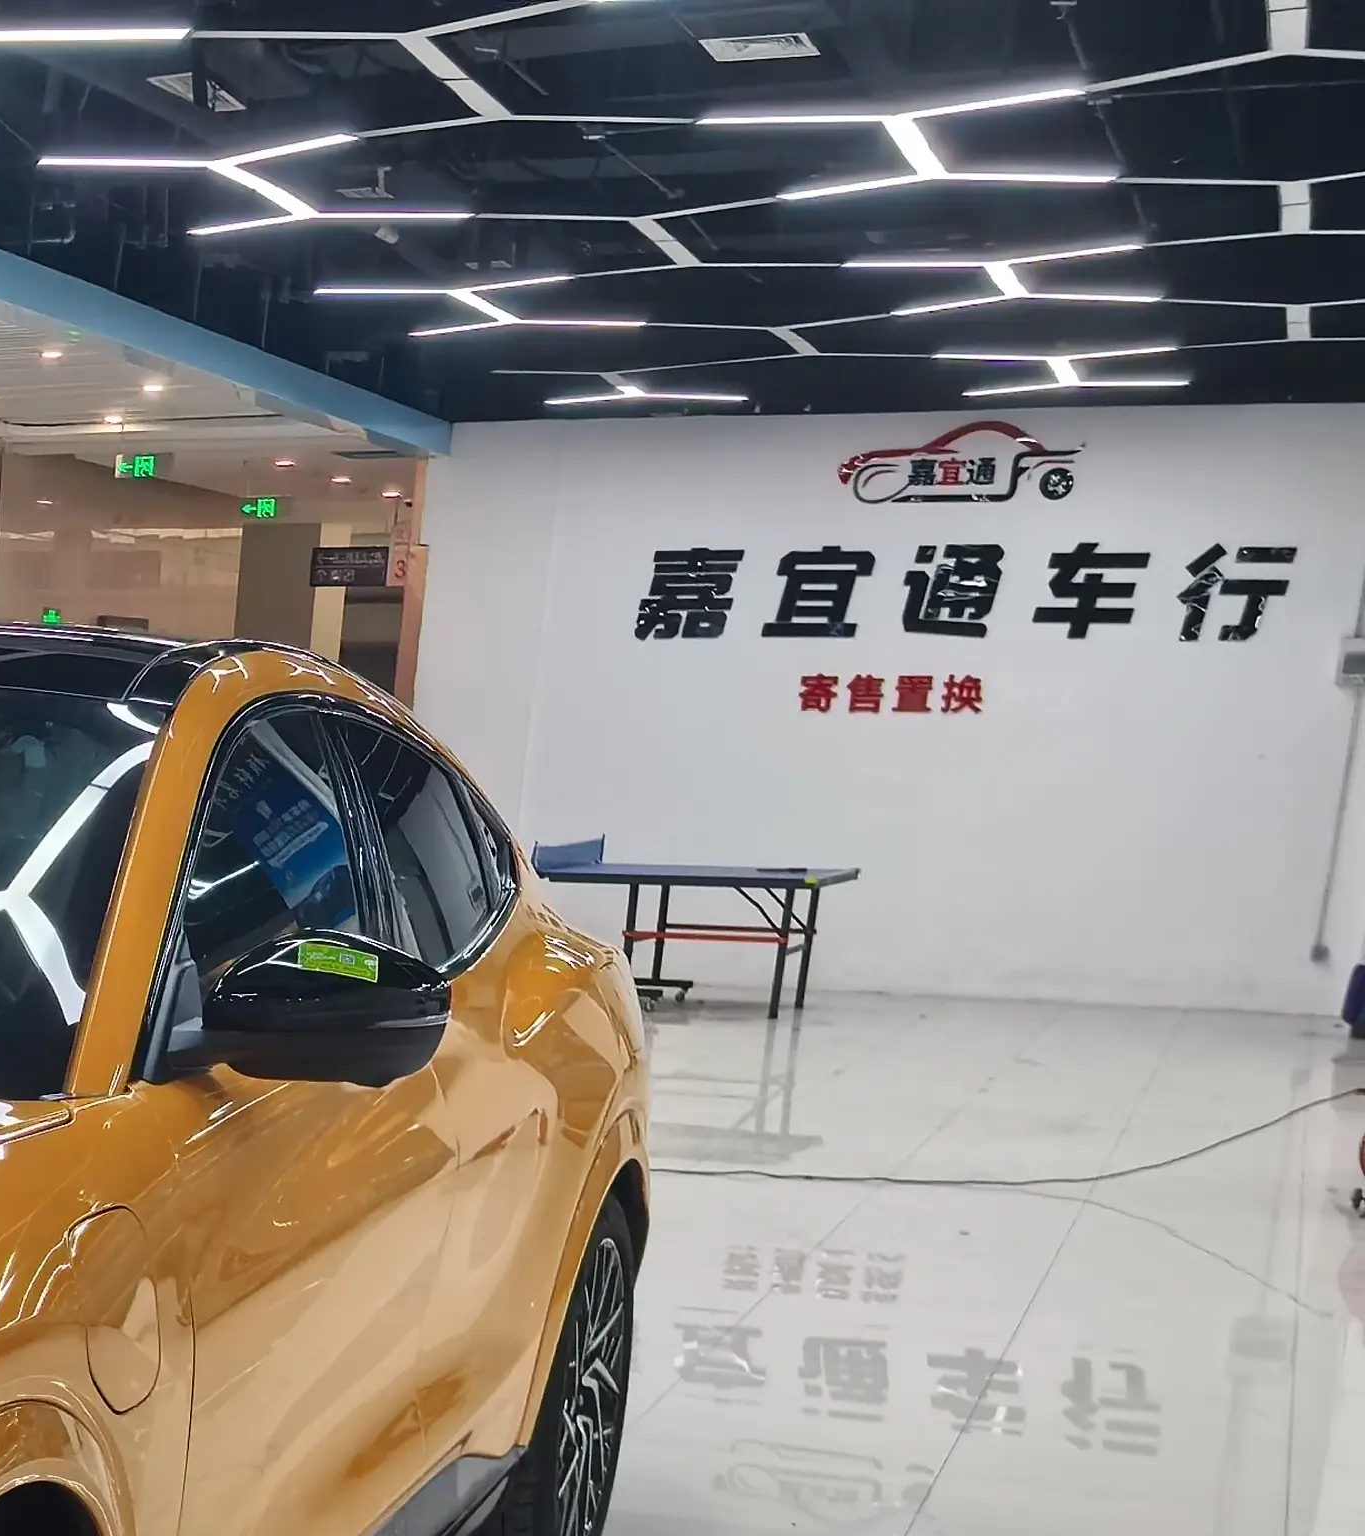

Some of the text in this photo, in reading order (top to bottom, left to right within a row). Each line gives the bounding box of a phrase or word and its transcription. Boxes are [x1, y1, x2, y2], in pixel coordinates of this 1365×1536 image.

[907, 456, 997, 487] 嘉宜通
[633, 542, 1299, 642] 嘉宜通车行
[798, 672, 984, 714] 寄售置换
